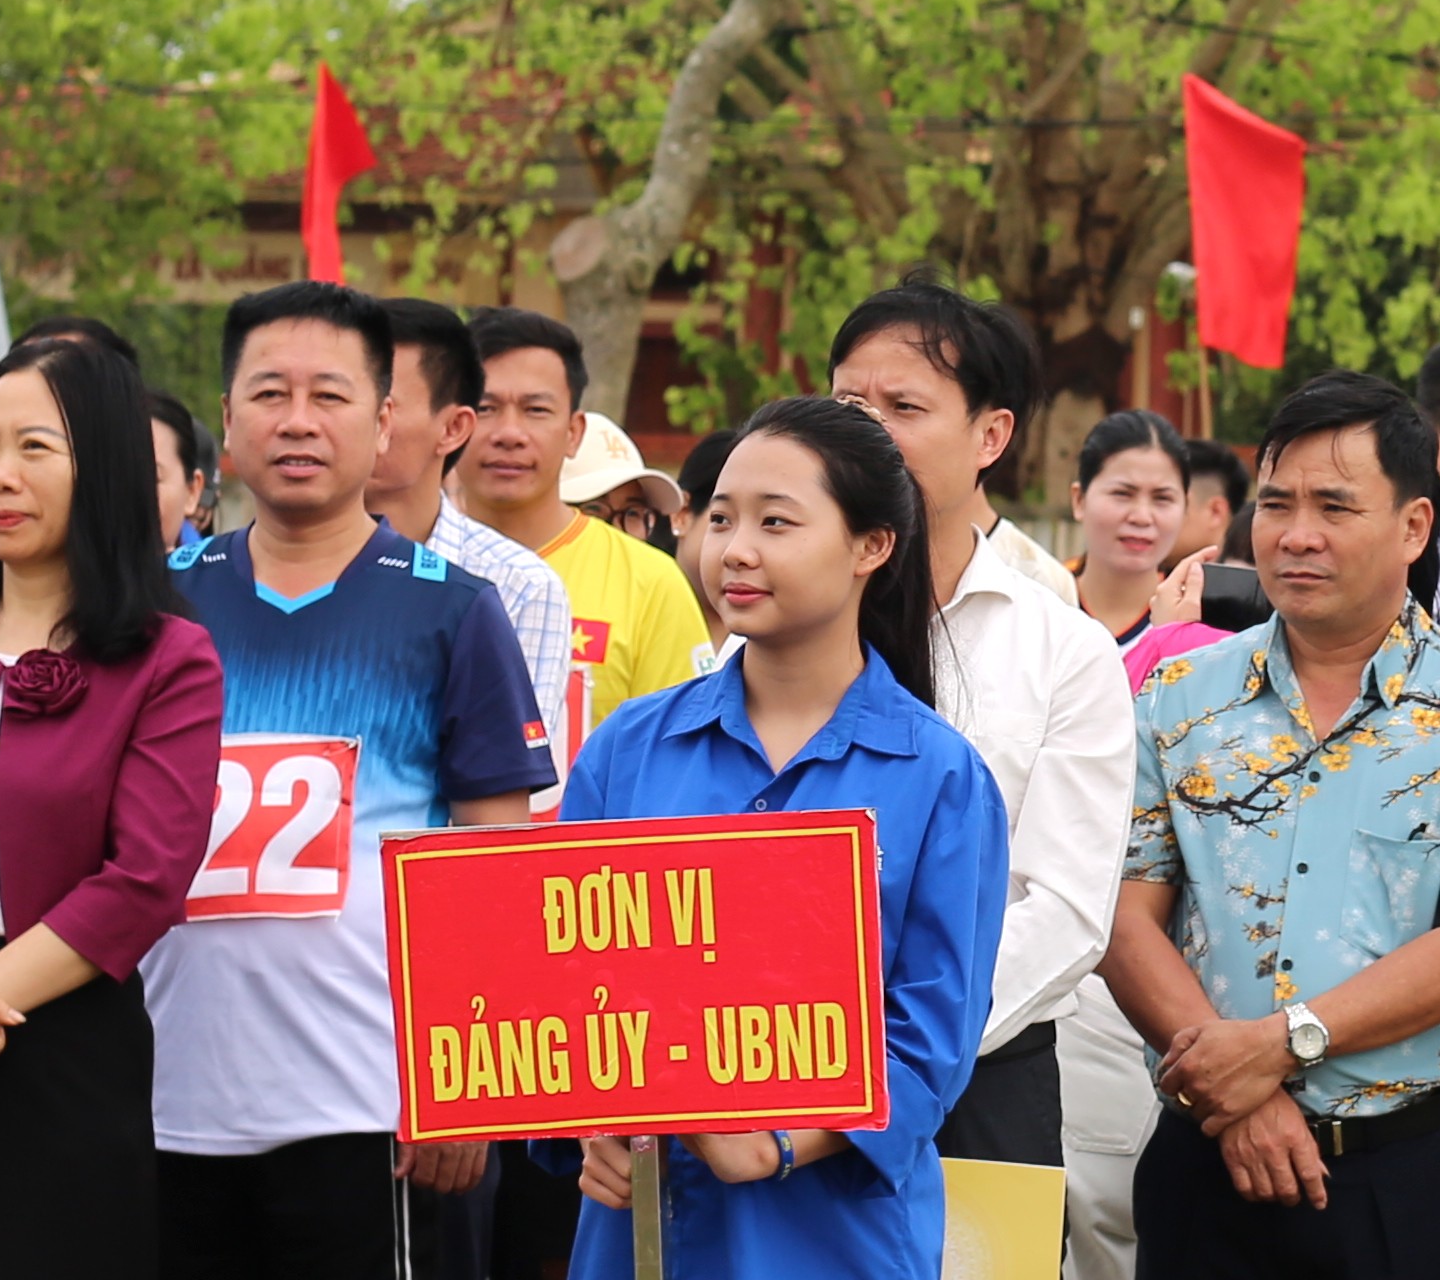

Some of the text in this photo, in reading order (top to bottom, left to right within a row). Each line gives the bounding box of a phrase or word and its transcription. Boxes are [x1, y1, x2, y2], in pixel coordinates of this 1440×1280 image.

[543, 865, 717, 963] ĐƠN VỊ
[429, 995, 571, 1103] ĐẢNG
[585, 986, 650, 1091] ỦY
[703, 1001, 848, 1084] UBND
